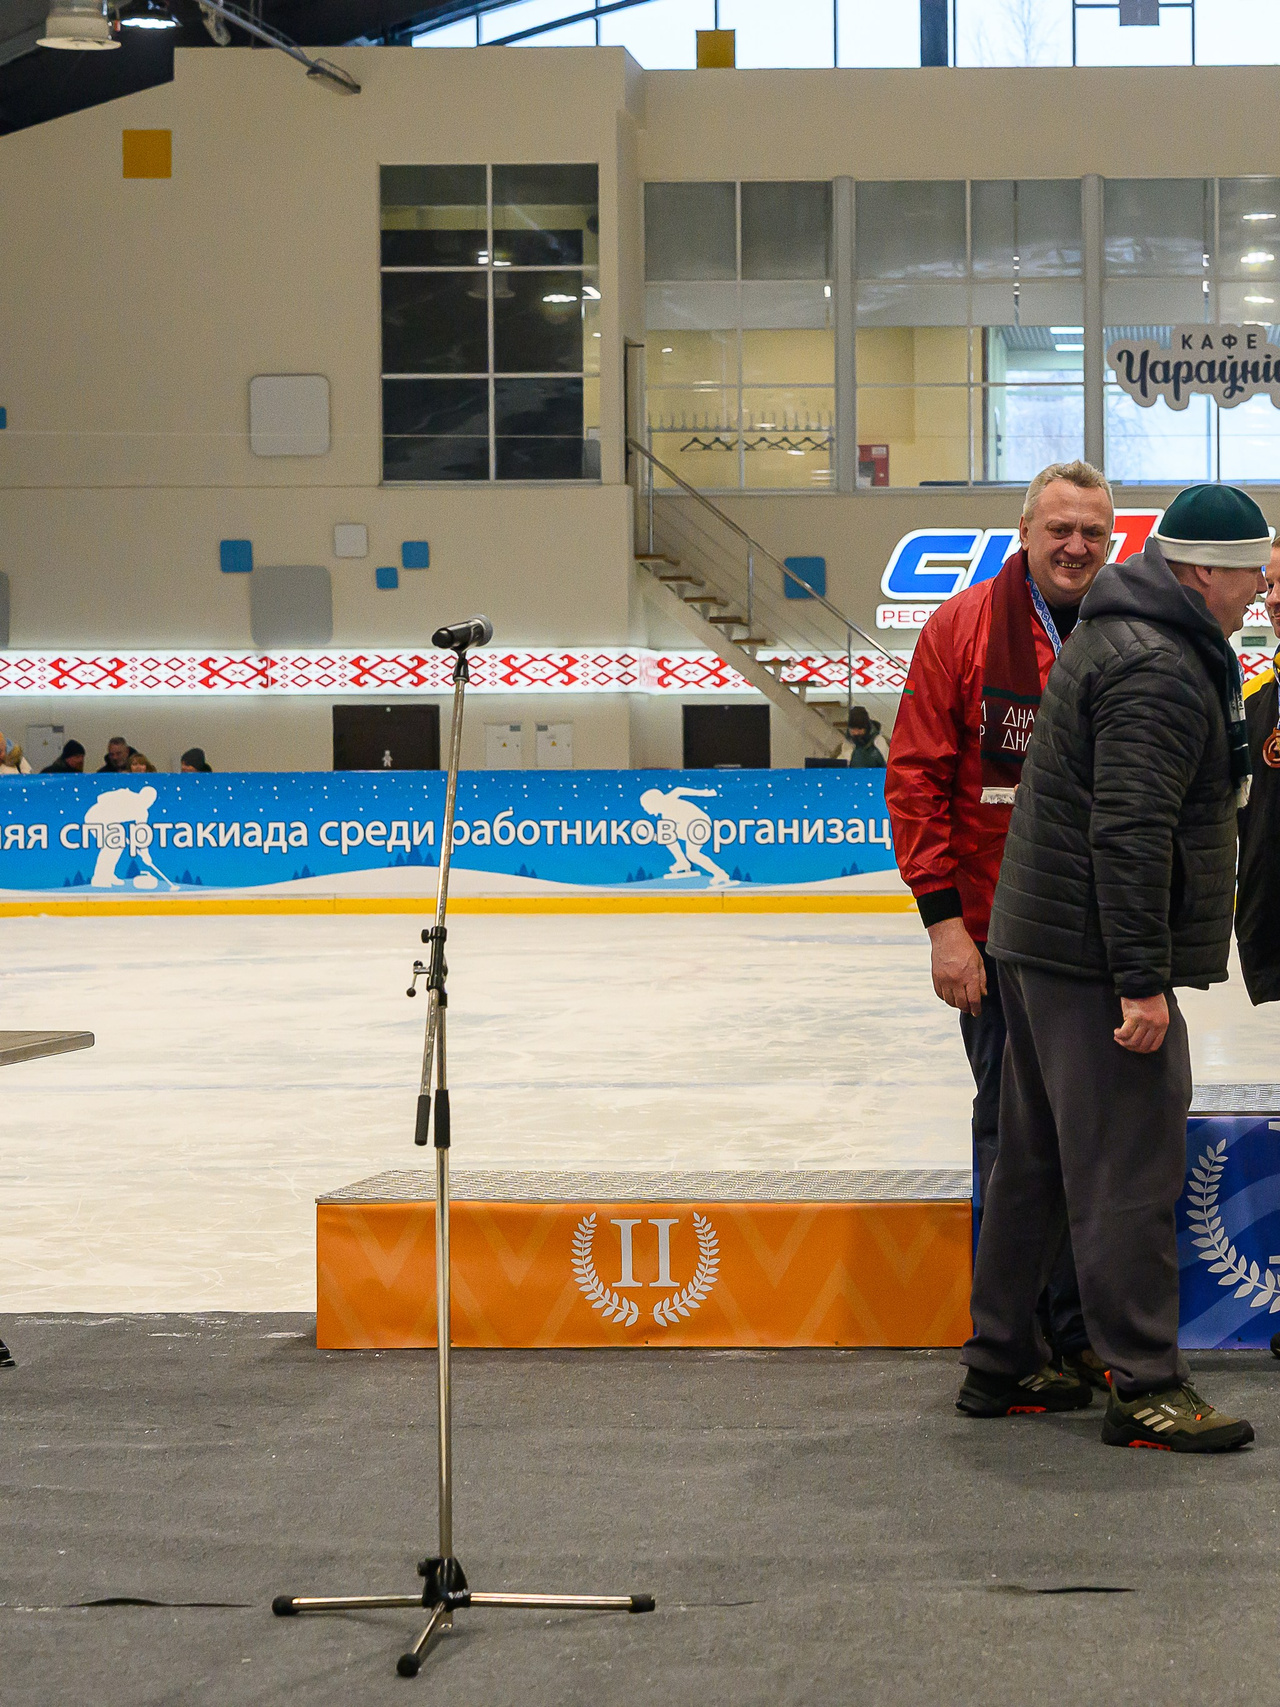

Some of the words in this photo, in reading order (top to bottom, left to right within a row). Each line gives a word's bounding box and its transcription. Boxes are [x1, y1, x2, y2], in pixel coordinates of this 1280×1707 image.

[1181, 333, 1257, 350] КАФЕ
[0, 823, 48, 850] яя
[59, 820, 309, 857] спартакиада
[319, 819, 435, 855] среди
[451, 810, 678, 854] работников
[610, 1218, 680, 1287] II
